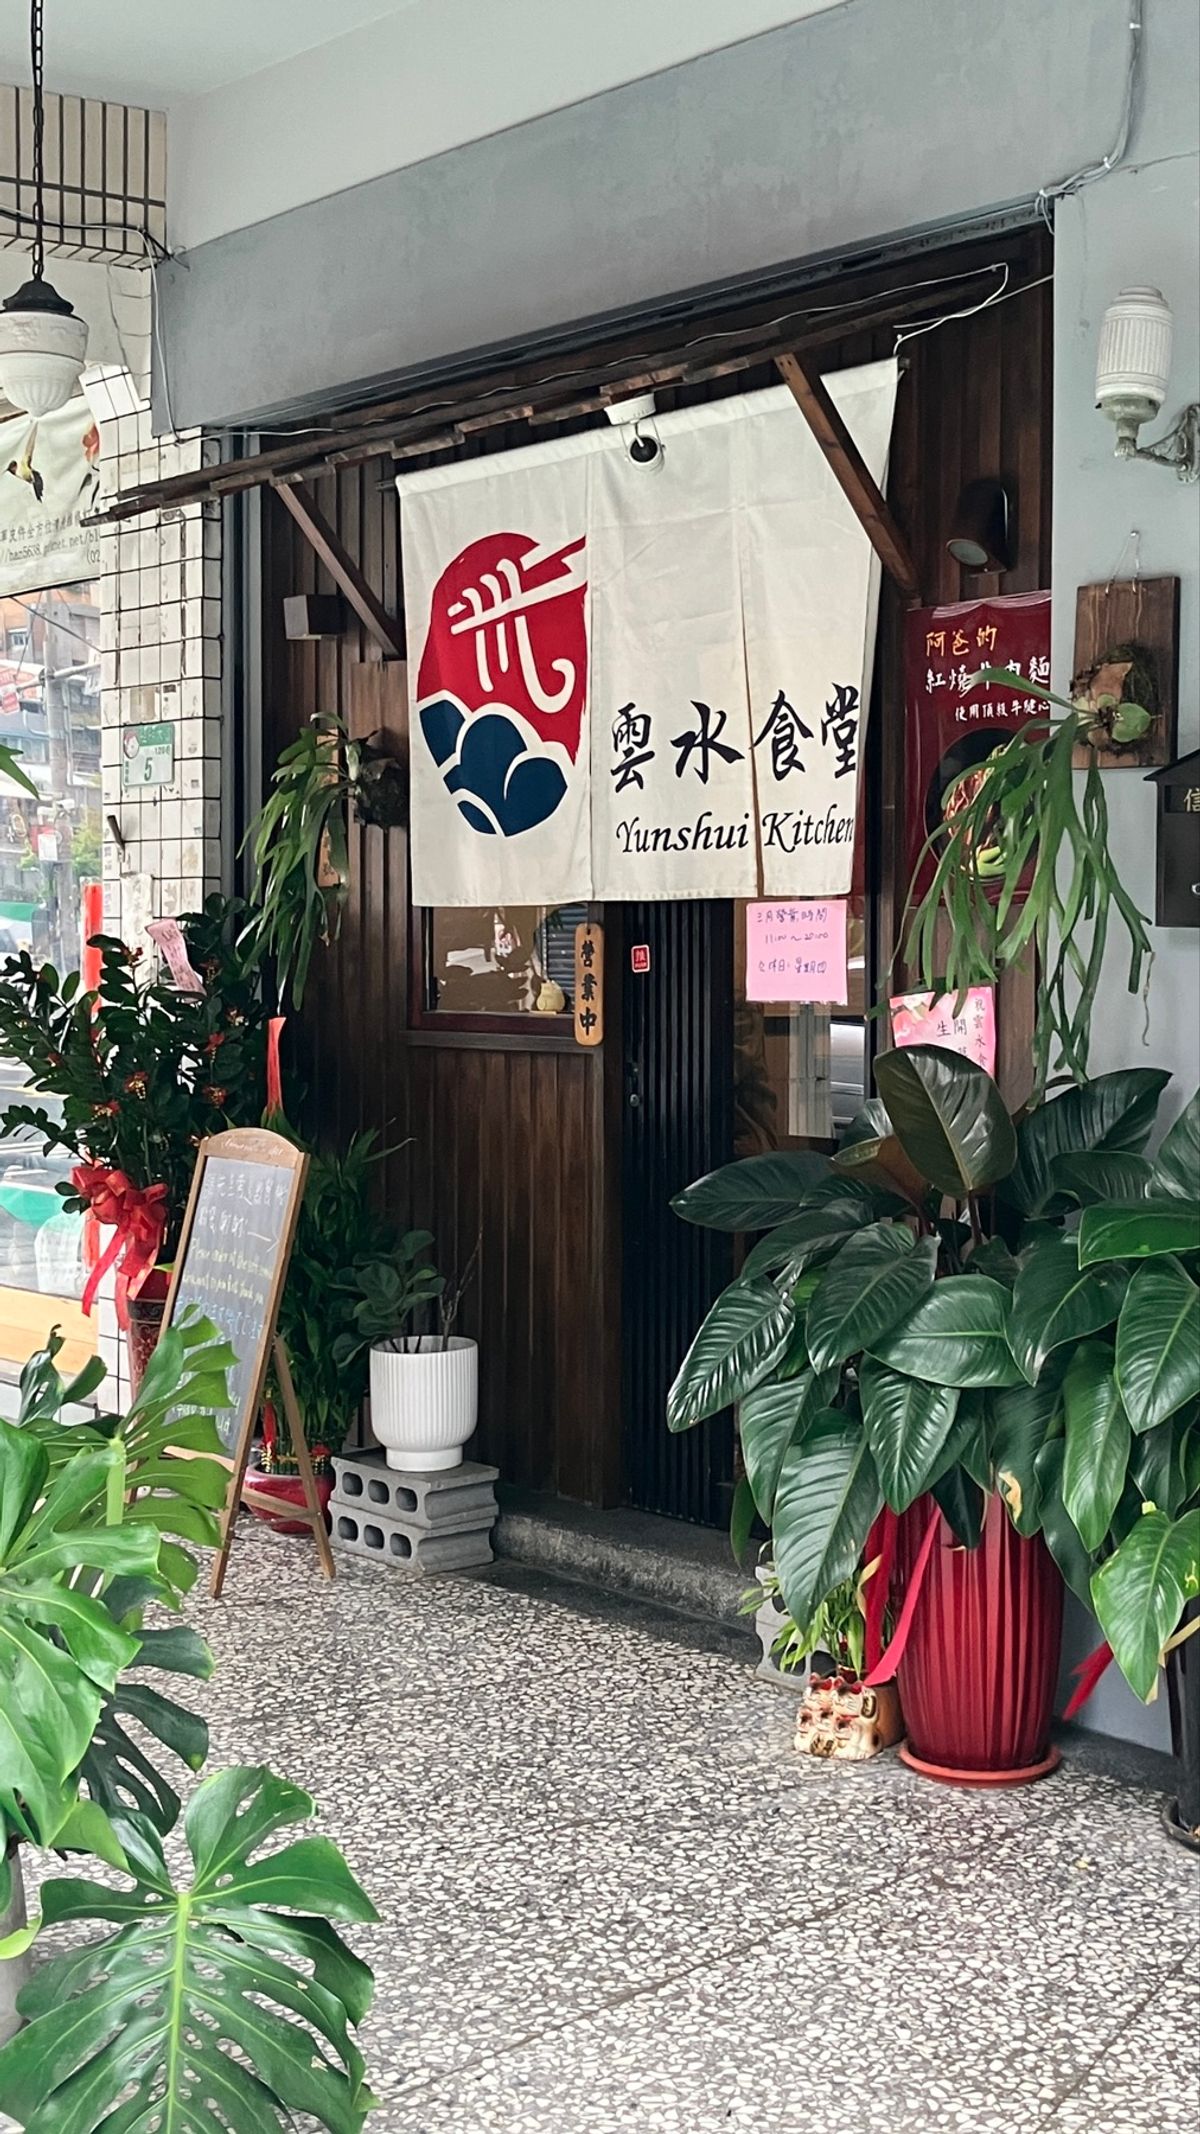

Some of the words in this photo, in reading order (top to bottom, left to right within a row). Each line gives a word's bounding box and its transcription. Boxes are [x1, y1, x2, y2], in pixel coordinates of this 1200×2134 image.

[925, 624, 998, 657] 阿爸的
[610, 682, 860, 793] 雲水食堂
[144, 757, 153, 781] 5
[616, 811, 750, 853] Yunshui
[761, 803, 854, 853] Kitchen
[579, 939, 598, 1036] 營業中
[936, 1020, 951, 1038] 生
